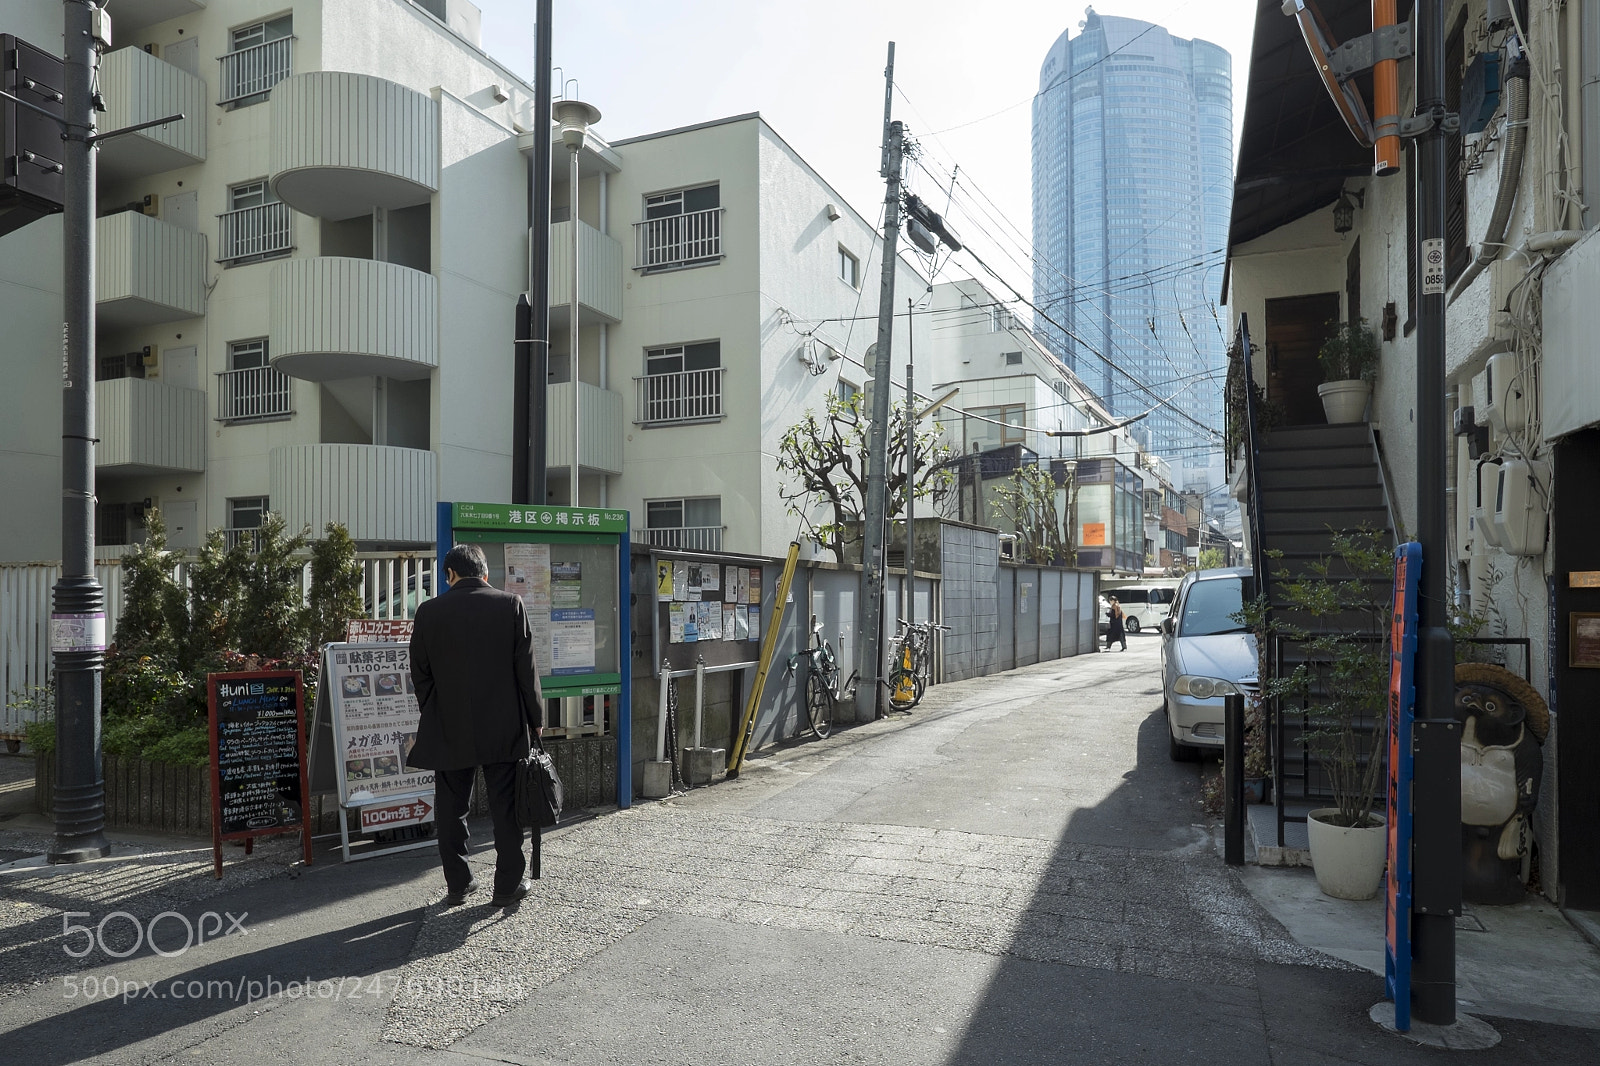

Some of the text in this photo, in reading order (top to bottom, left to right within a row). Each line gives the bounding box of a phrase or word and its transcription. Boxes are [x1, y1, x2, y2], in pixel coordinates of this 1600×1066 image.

[508, 510, 600, 527] 港区 掲示板
[604, 512, 625, 521] No.236
[350, 620, 414, 634] 赤いコカコーラの
[220, 682, 249, 697] #uni
[346, 730, 405, 750] メガ盛り丼
[363, 804, 425, 824] 100m先 左
